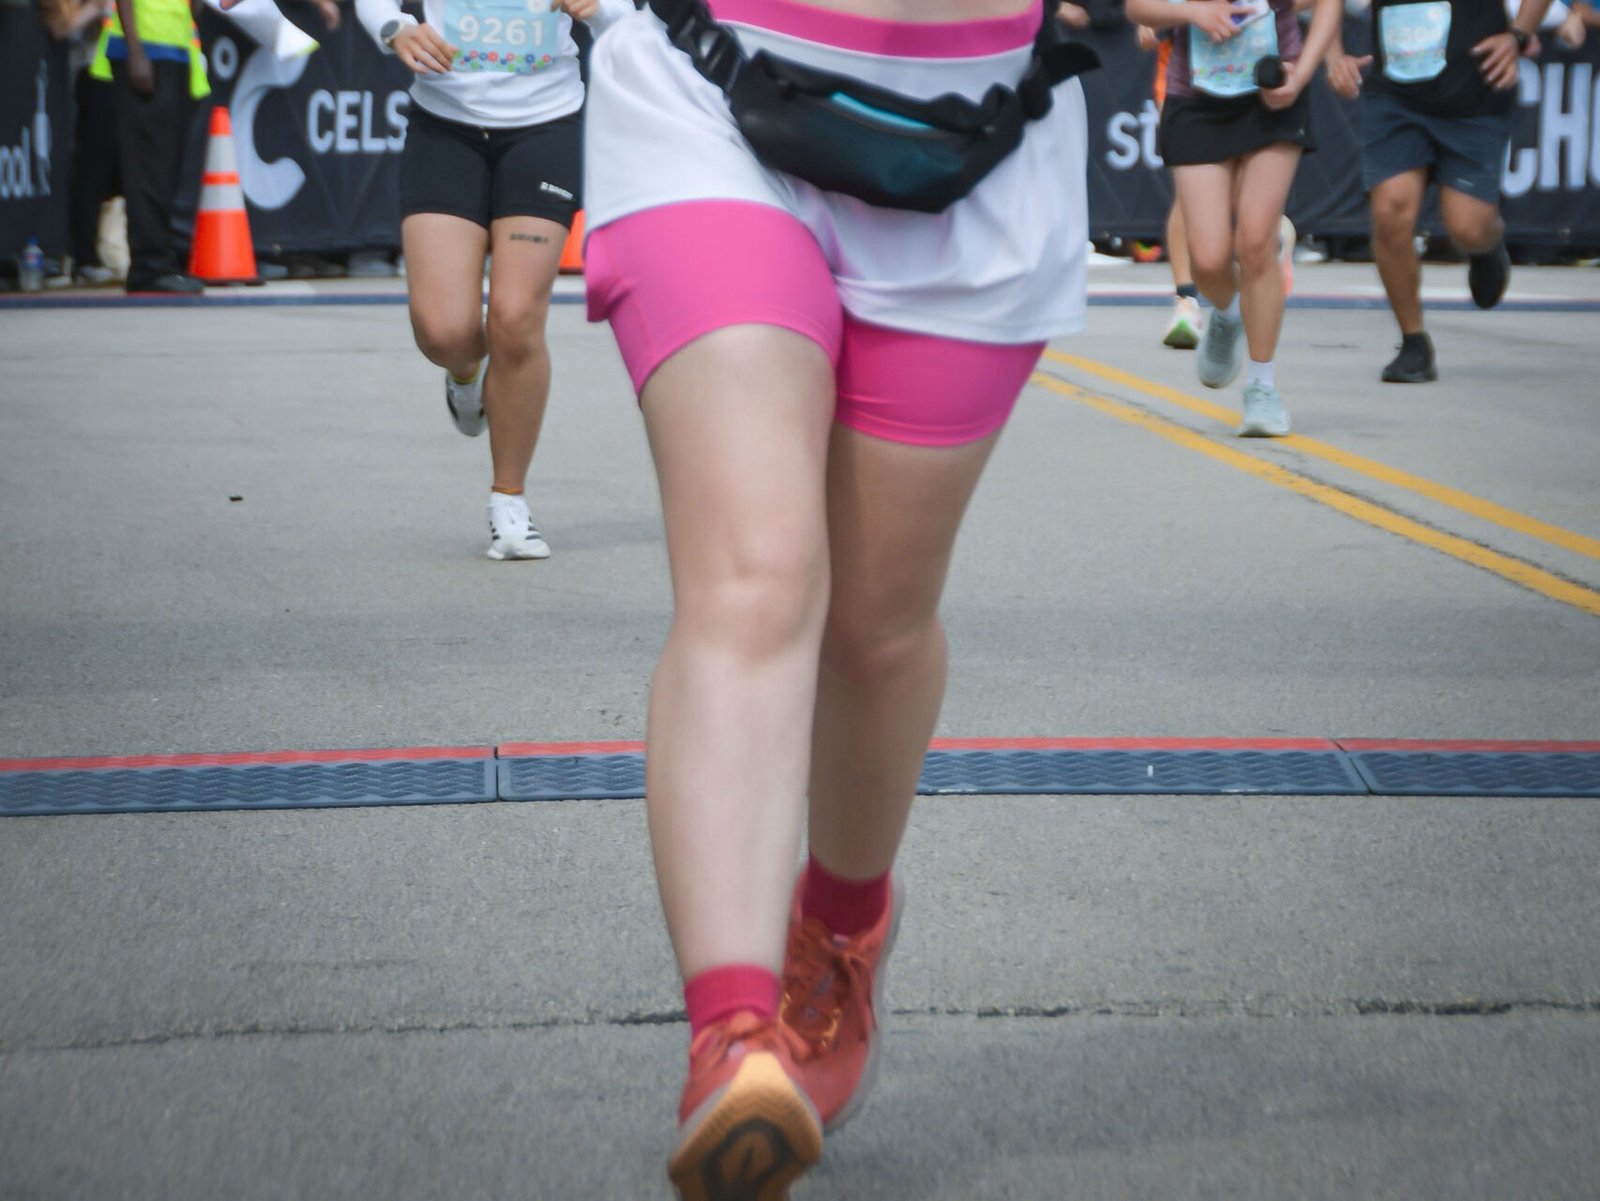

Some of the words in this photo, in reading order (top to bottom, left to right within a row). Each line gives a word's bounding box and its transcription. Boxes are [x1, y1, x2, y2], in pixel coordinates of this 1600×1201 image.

[459, 15, 543, 47] 9261
[308, 89, 410, 154] CELS
[1502, 57, 1600, 198] CH
